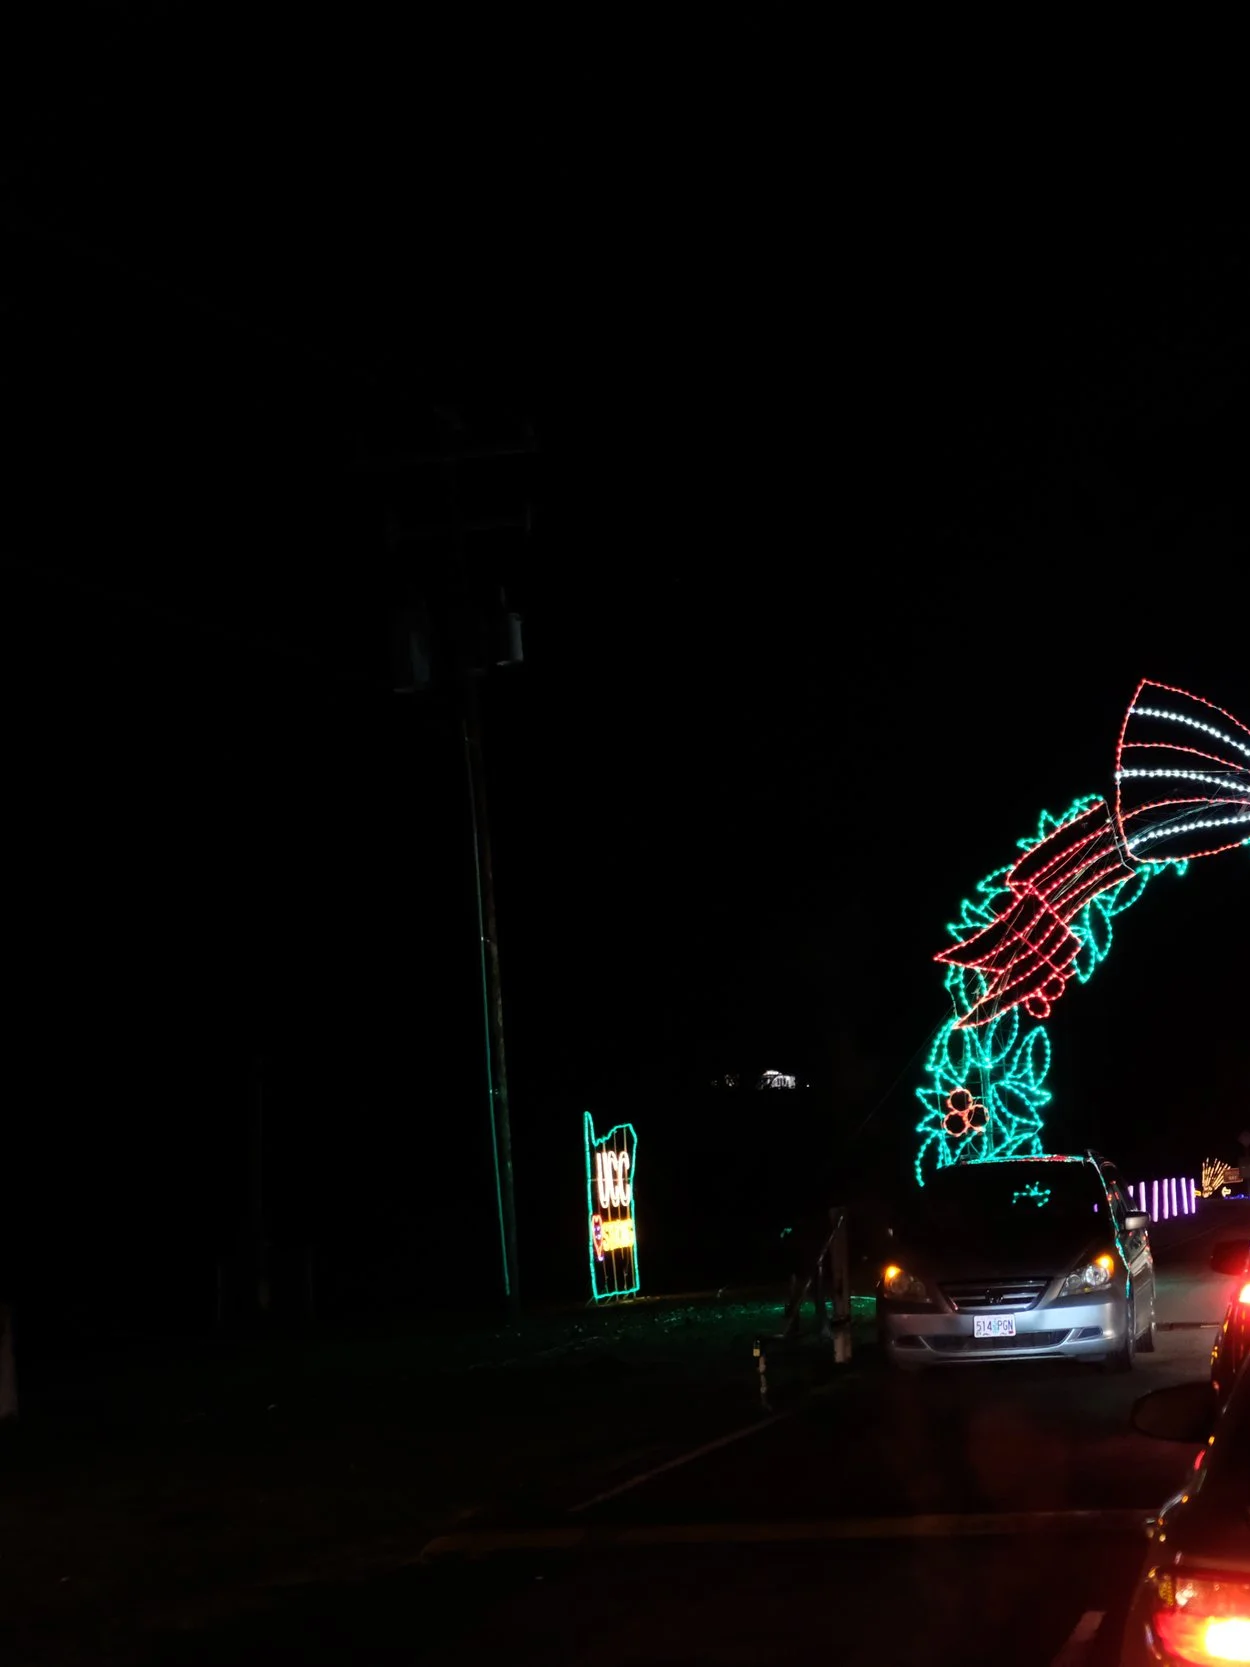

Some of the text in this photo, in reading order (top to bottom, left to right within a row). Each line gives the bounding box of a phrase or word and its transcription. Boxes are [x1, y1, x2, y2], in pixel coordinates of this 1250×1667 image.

[596, 1151, 630, 1208] UCC
[976, 1320, 1013, 1332] 514 PGN
